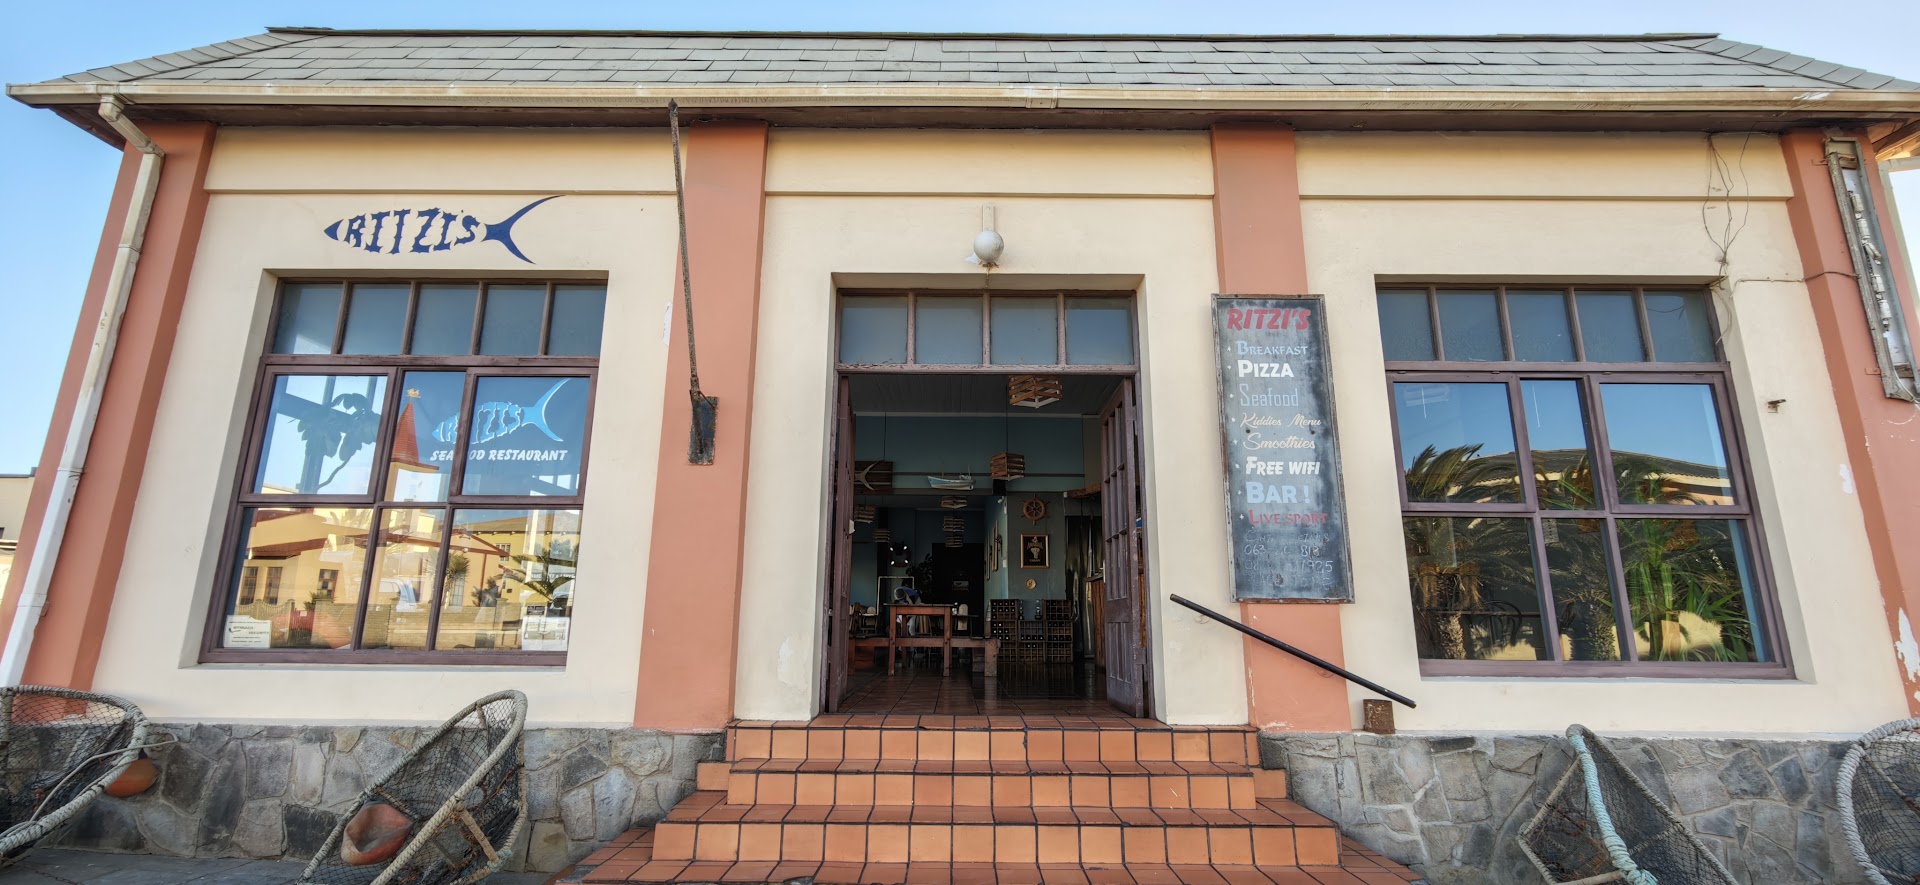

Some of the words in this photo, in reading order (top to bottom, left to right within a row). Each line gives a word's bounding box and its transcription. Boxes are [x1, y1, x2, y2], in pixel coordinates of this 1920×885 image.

[1226, 308, 1312, 331] RITZI'S
[1236, 340, 1309, 356] BREAKFAST
[1237, 359, 1295, 378] PIZZA
[1239, 383, 1299, 407] Seafood
[1240, 412, 1282, 429] Kiddies
[1287, 413, 1322, 429] Menu
[1243, 432, 1316, 450] Smoothies
[429, 449, 486, 462] SEAOD
[488, 449, 568, 461] RESTAURANT
[1245, 456, 1284, 476] FREE
[1288, 461, 1321, 475] WIFI
[1248, 509, 1282, 525] LIVE
[1285, 513, 1328, 525] SPORT
